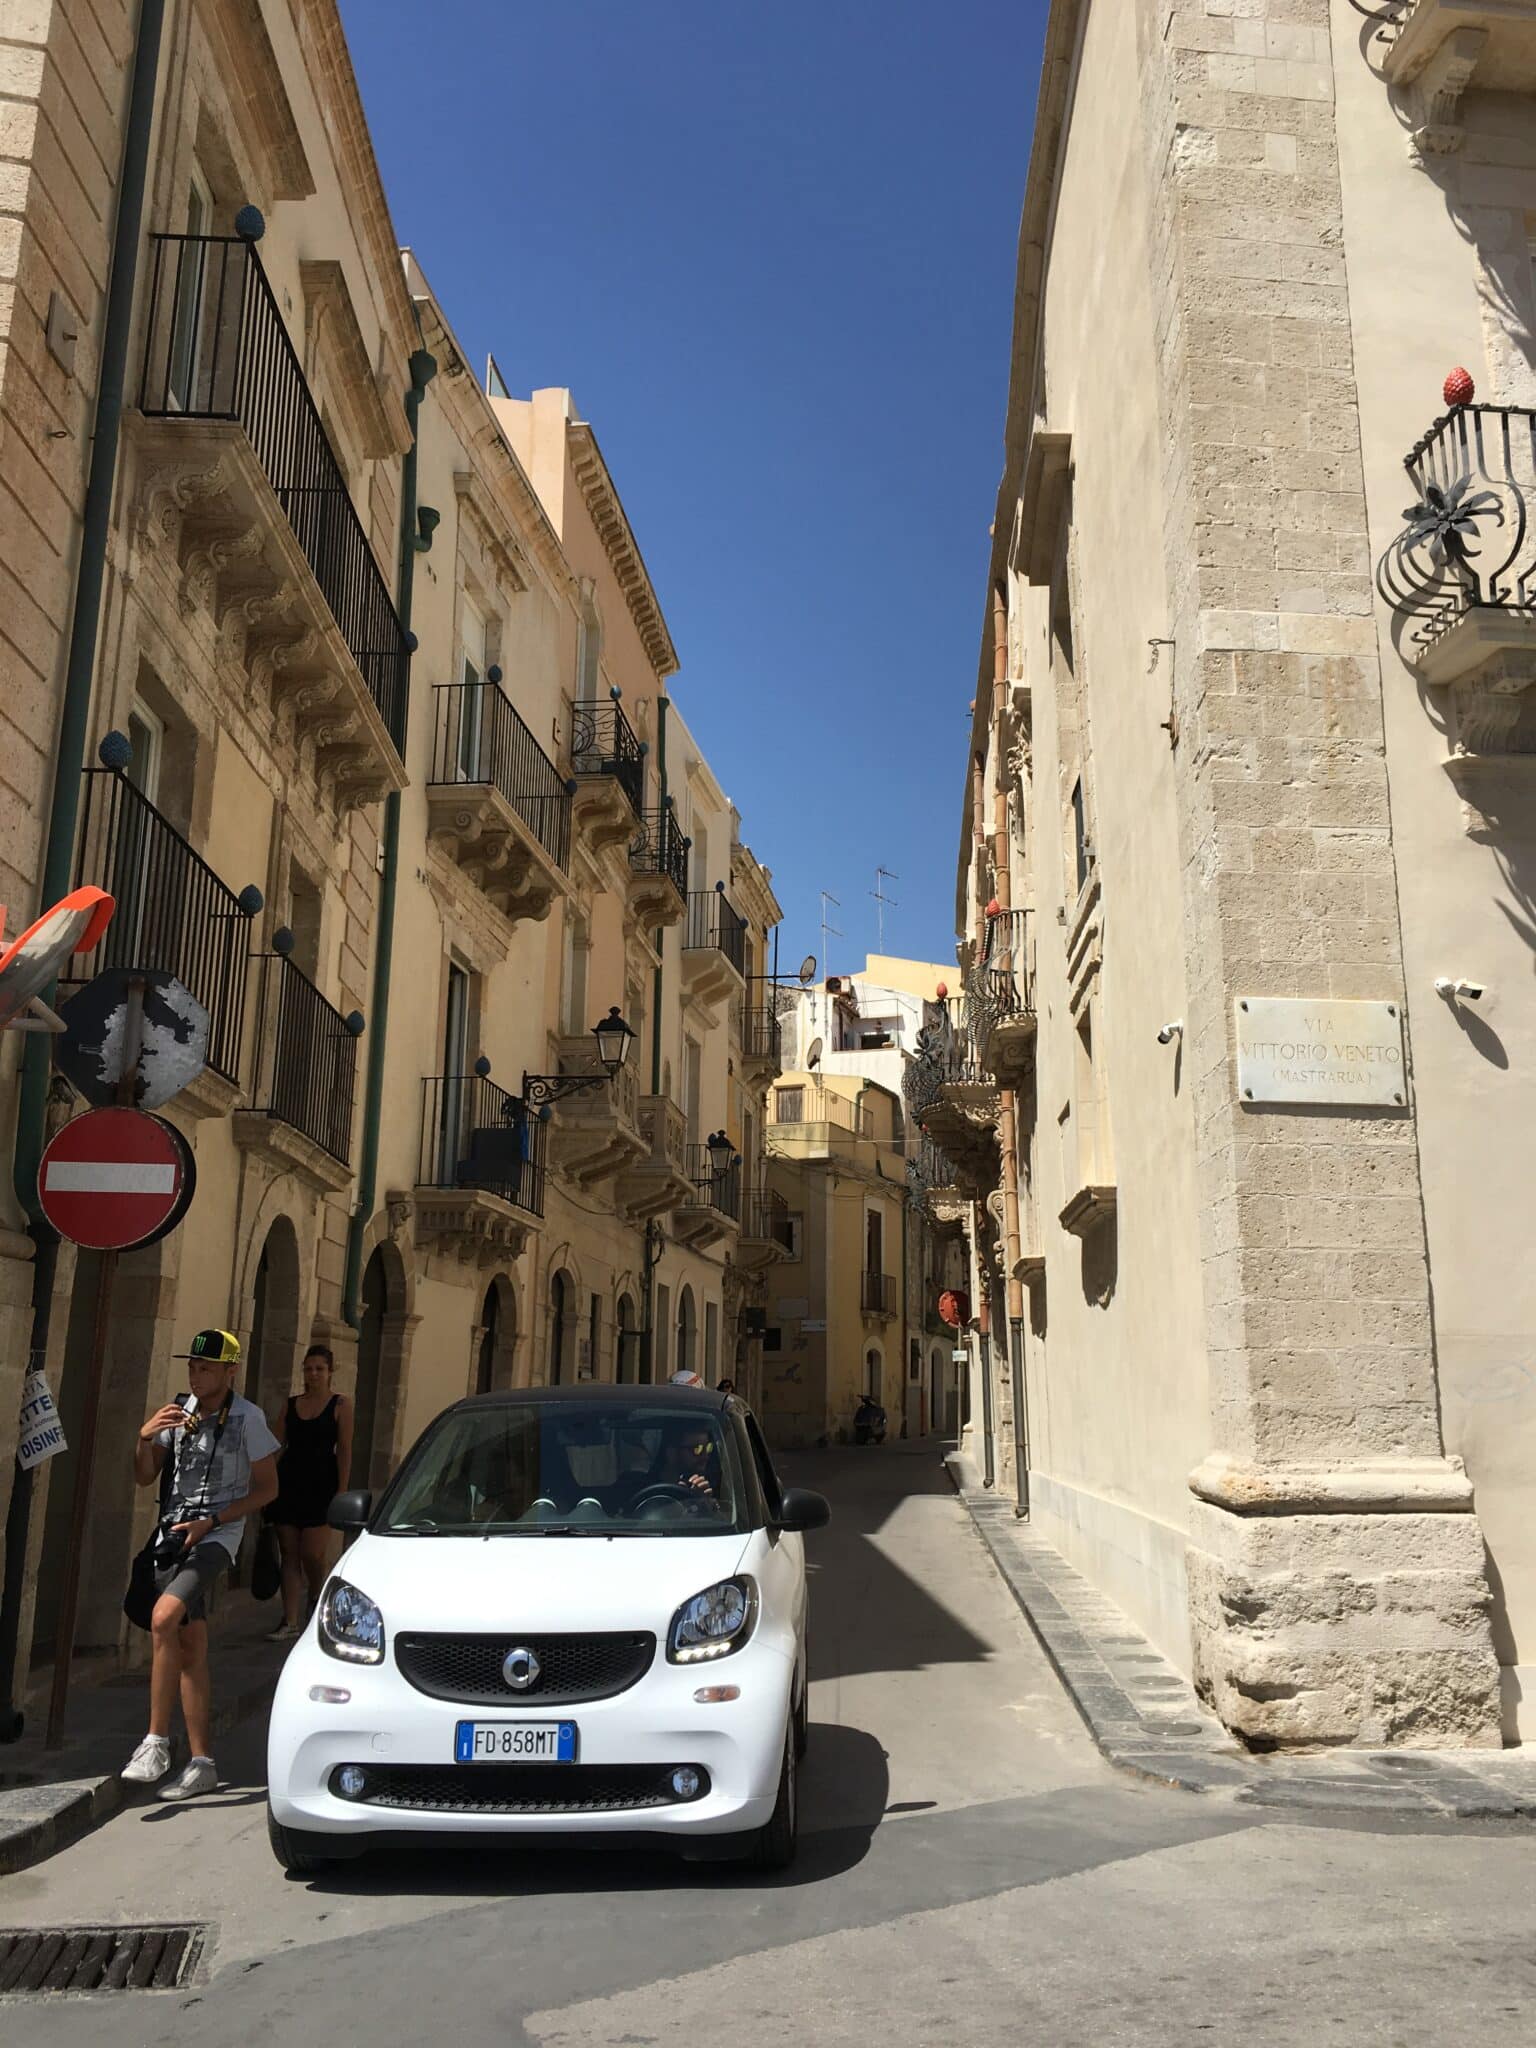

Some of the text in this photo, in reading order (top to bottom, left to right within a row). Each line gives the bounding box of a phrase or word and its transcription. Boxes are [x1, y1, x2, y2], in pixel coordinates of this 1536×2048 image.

[1303, 1018, 1335, 1033] VIA
[1241, 1041, 1400, 1063] VITTORIO VENETO
[19, 1394, 53, 1425] TTE
